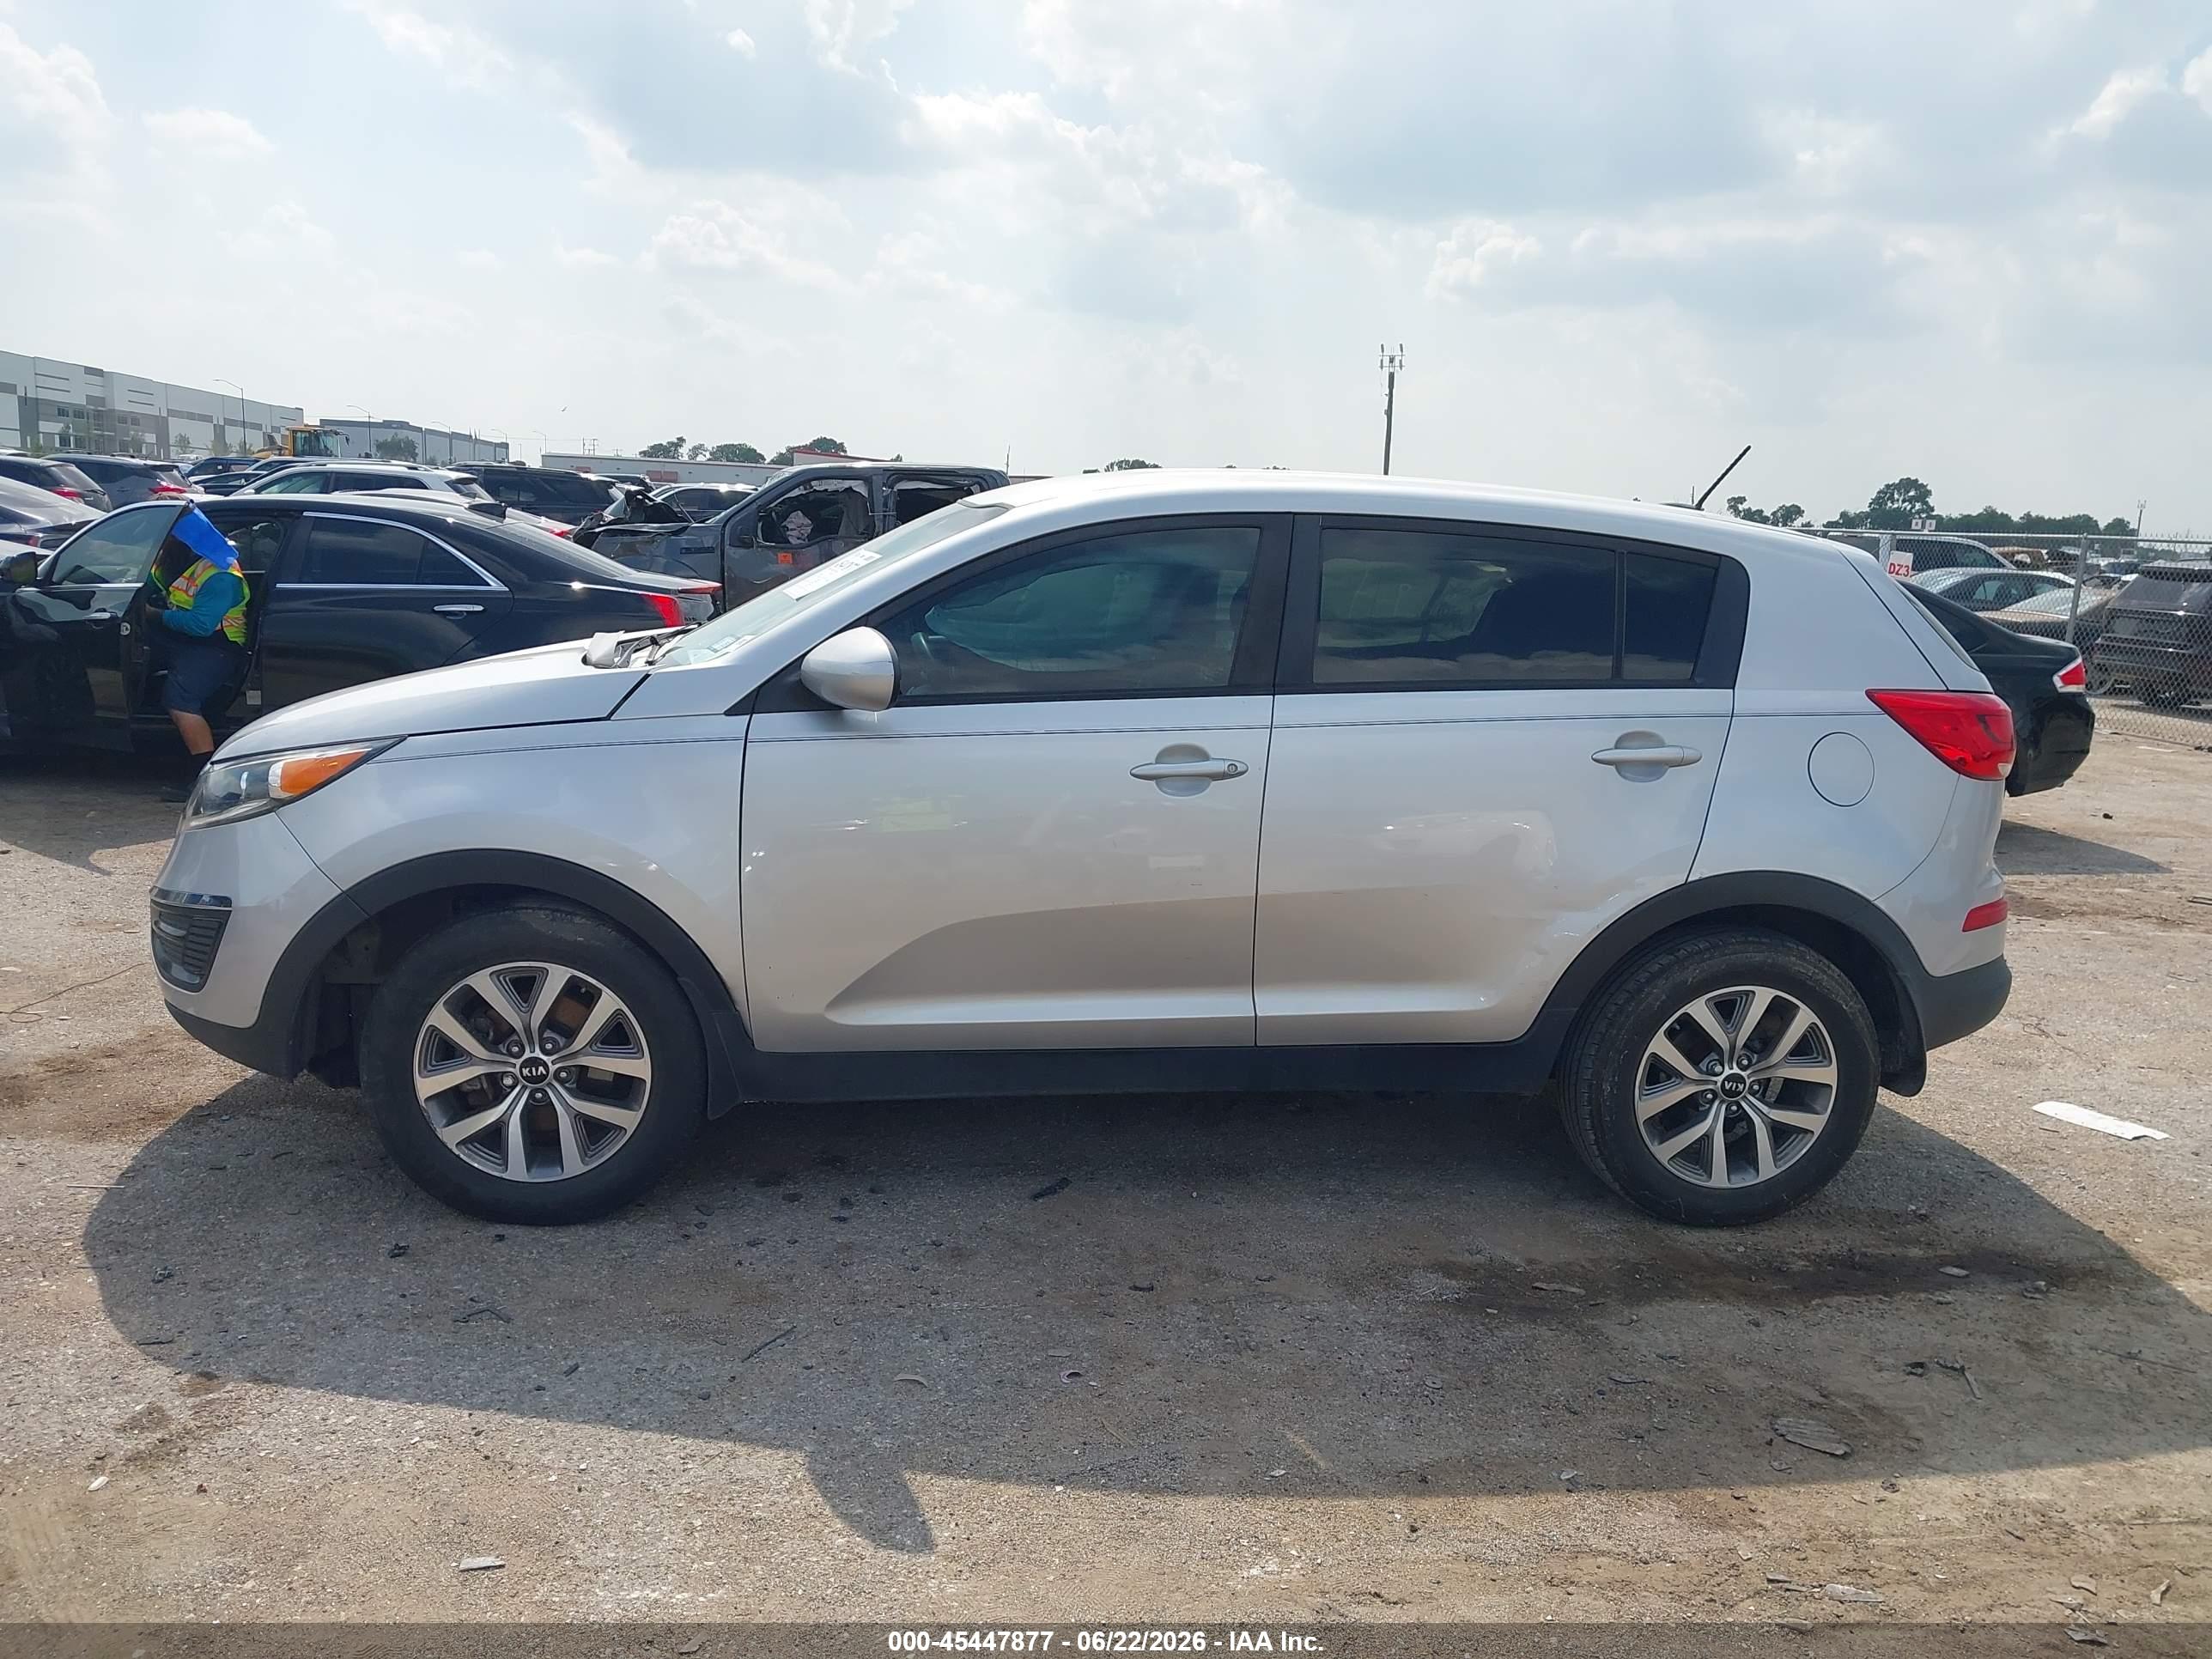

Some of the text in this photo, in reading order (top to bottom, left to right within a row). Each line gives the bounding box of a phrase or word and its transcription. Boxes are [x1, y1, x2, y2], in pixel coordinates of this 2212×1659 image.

[1887, 562, 1910, 577] DZ3
[521, 1066, 547, 1077] KIA
[1724, 1080, 1744, 1091] KIA
